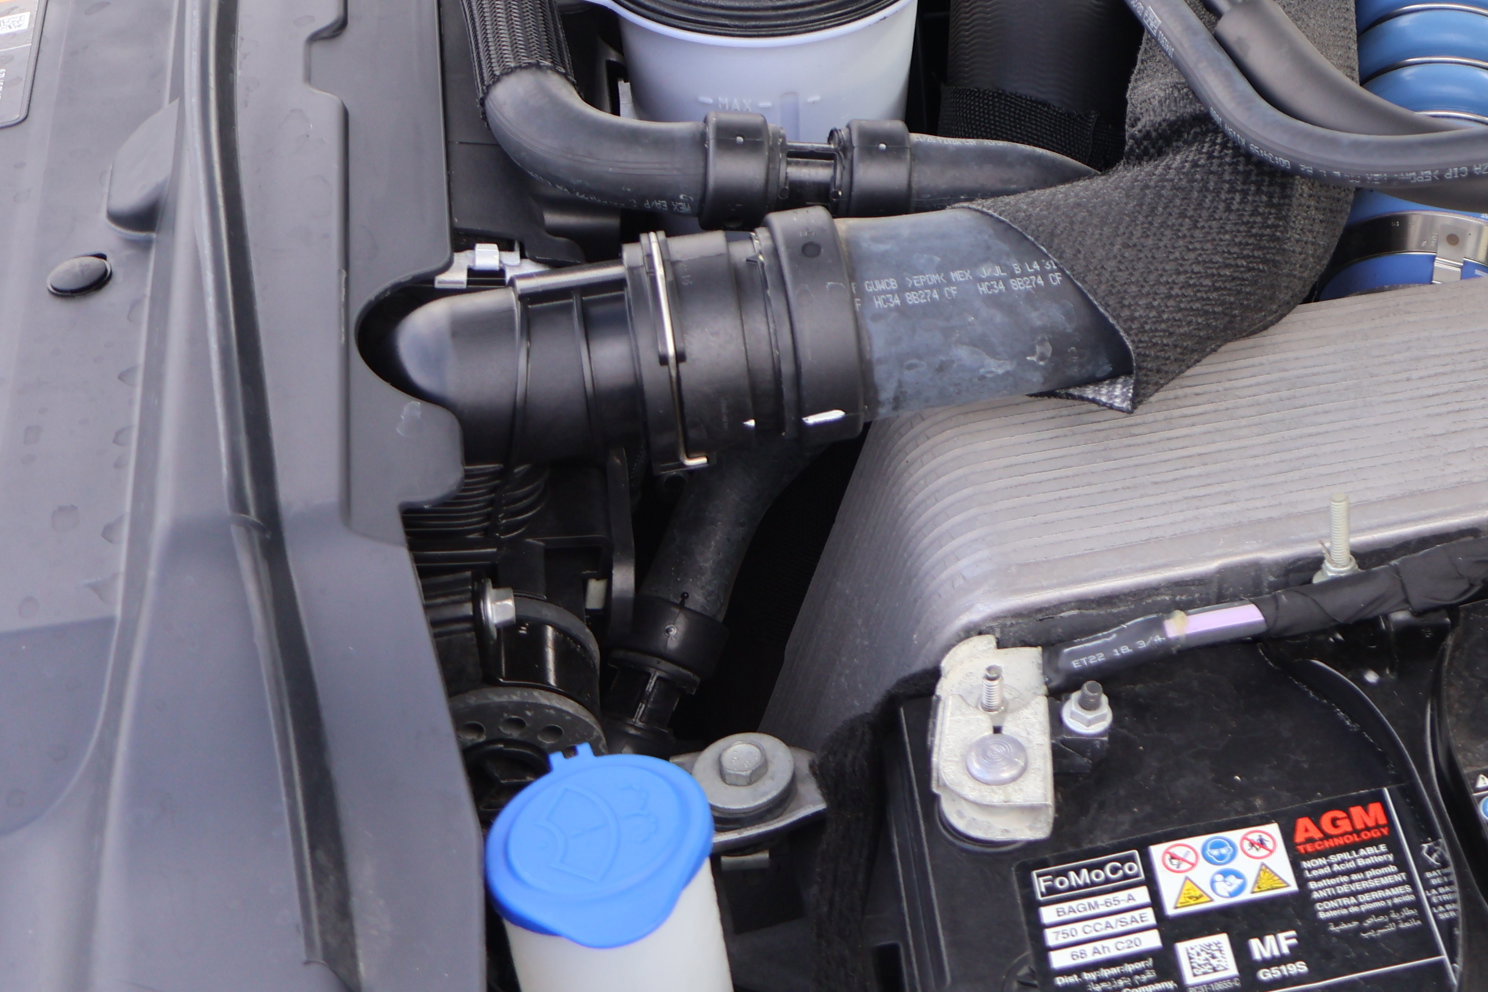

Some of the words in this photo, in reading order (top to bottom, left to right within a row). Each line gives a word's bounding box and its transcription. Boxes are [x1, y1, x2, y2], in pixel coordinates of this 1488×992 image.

[718, 96, 752, 111] MAX
[950, 269, 973, 282] MEX
[1294, 801, 1388, 843] AGM
[1296, 827, 1391, 854] TECHNOLOGY
[1301, 844, 1388, 869] NON-SPILLABLE
[1305, 865, 1331, 878] Lead
[1332, 860, 1356, 873] Acid
[1357, 853, 1394, 869] Battery
[1038, 861, 1139, 894] FoMoCo
[1308, 874, 1350, 889] Batterie
[1351, 872, 1364, 881] au
[1366, 865, 1398, 880] plomb
[1055, 893, 1136, 918] BAGM-65-A
[1312, 888, 1336, 900] ANTI
[1315, 895, 1357, 911] CONTRA
[1358, 885, 1413, 904] DERRAMES
[1053, 927, 1079, 942] 750
[1082, 912, 1150, 937] CCA/SAE
[1070, 948, 1088, 961] 68
[1091, 944, 1111, 958] Ah
[1114, 937, 1142, 952] C20
[1248, 930, 1300, 962] MF
[1055, 971, 1082, 986] Dist.
[1257, 960, 1309, 982] G519S
